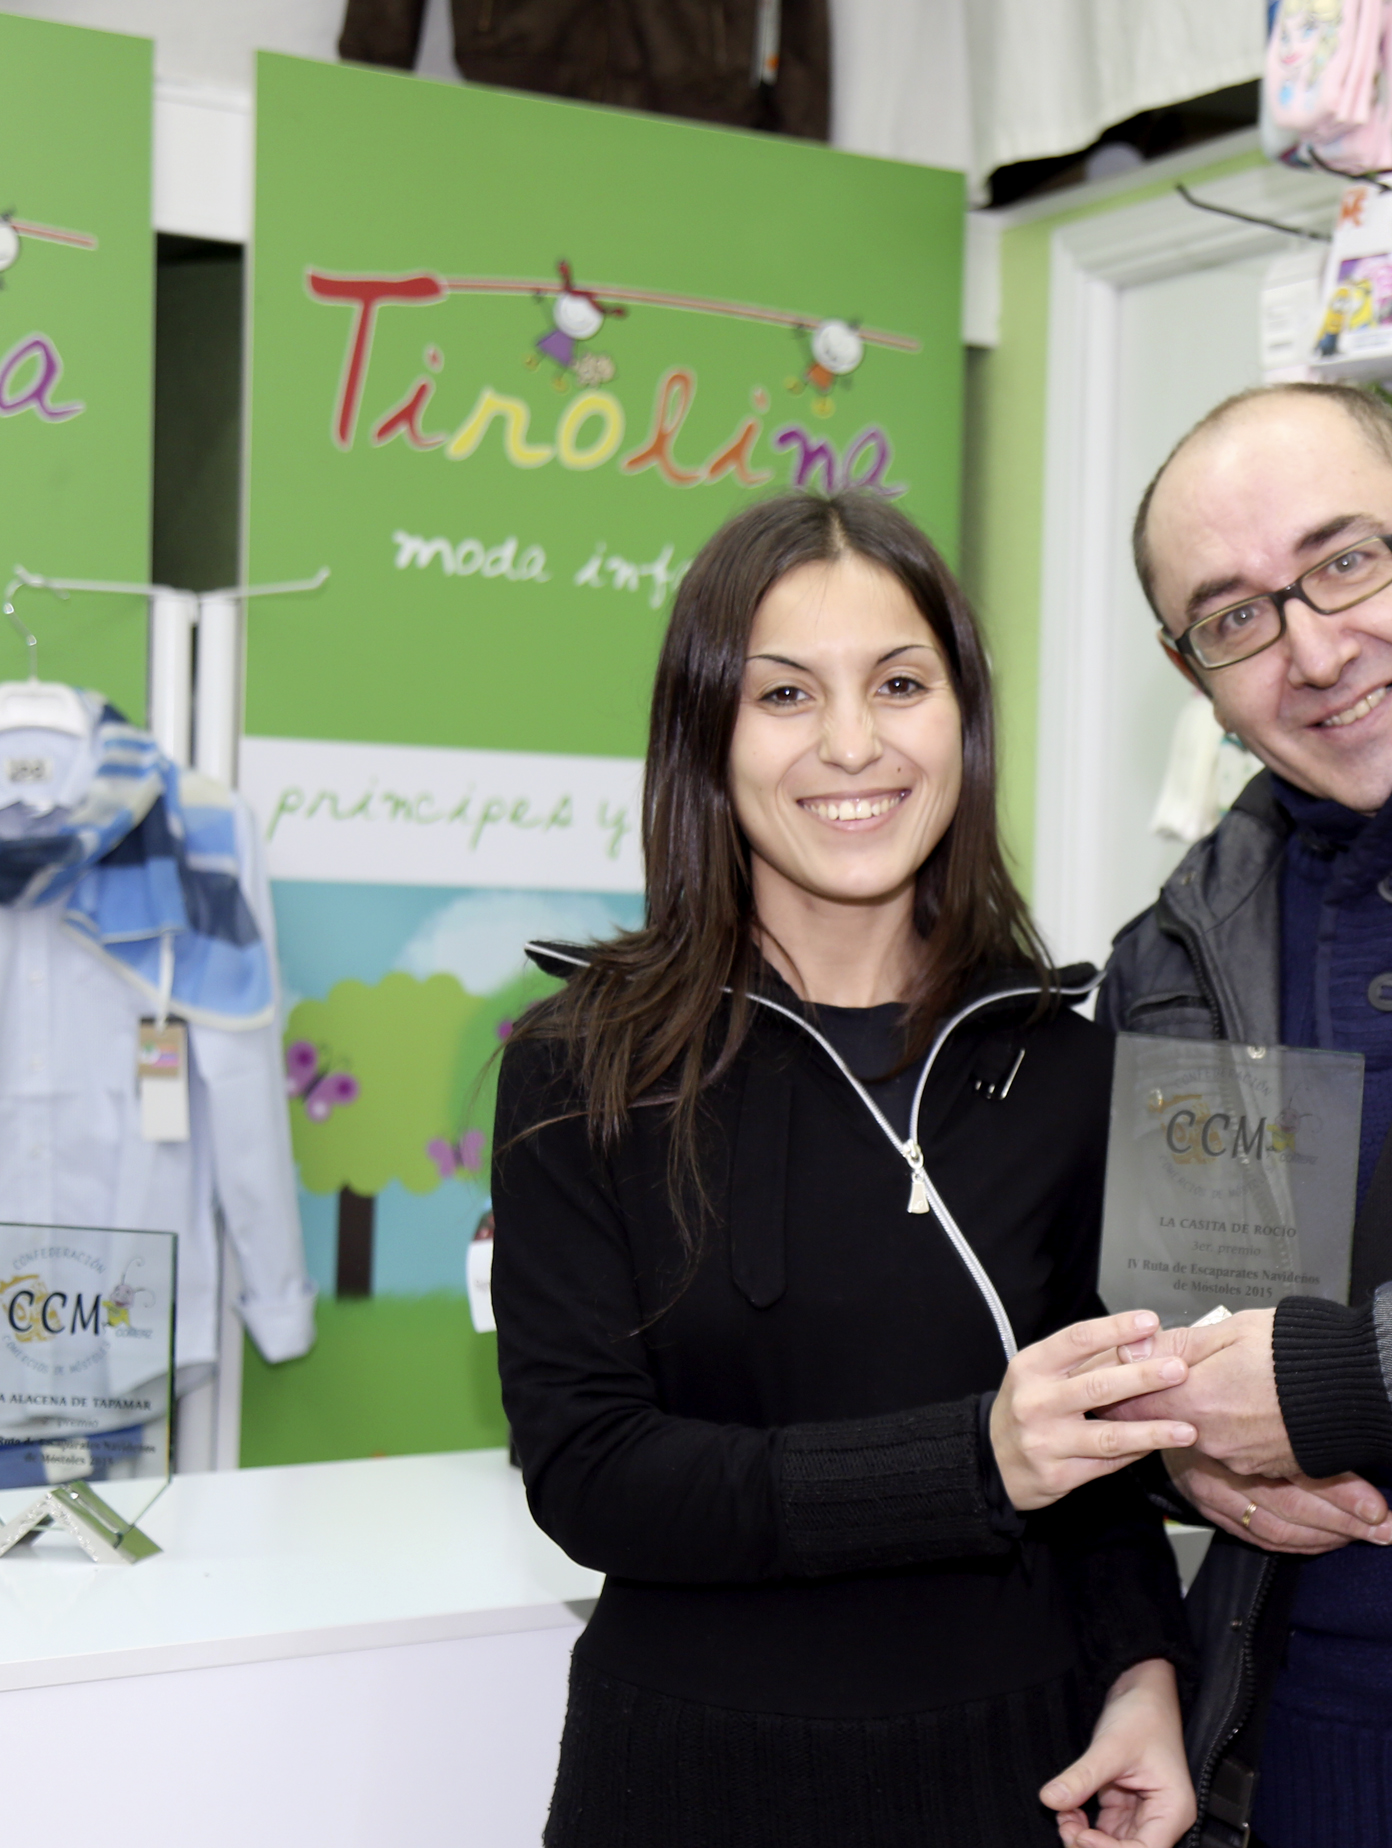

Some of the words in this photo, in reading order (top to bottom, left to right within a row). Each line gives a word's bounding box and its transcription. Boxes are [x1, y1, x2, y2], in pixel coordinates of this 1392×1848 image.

[305, 264, 908, 500] Tirolina
[392, 528, 553, 584] moda
[267, 777, 574, 853] principes
[597, 795, 632, 861] y
[1166, 1109, 1267, 1160] CCM
[1159, 1216, 1176, 1228] LA
[1180, 1218, 1227, 1233] CASITA
[1231, 1222, 1250, 1235] DE
[1217, 1244, 1262, 1257] premio
[1127, 1258, 1140, 1270] IV
[1142, 1259, 1170, 1273] Ruta
[1172, 1262, 1188, 1274] de
[1190, 1264, 1259, 1280] Escaparates
[1262, 1269, 1321, 1285] Navideños
[1173, 1279, 1188, 1291] de
[1191, 1280, 1242, 1296] Móstoles
[1244, 1284, 1273, 1298] 2015
[8, 1289, 102, 1336] CCM
[9, 1394, 67, 1408] ALACENA
[71, 1396, 88, 1408] DE
[93, 1397, 152, 1411] TAPAMAR
